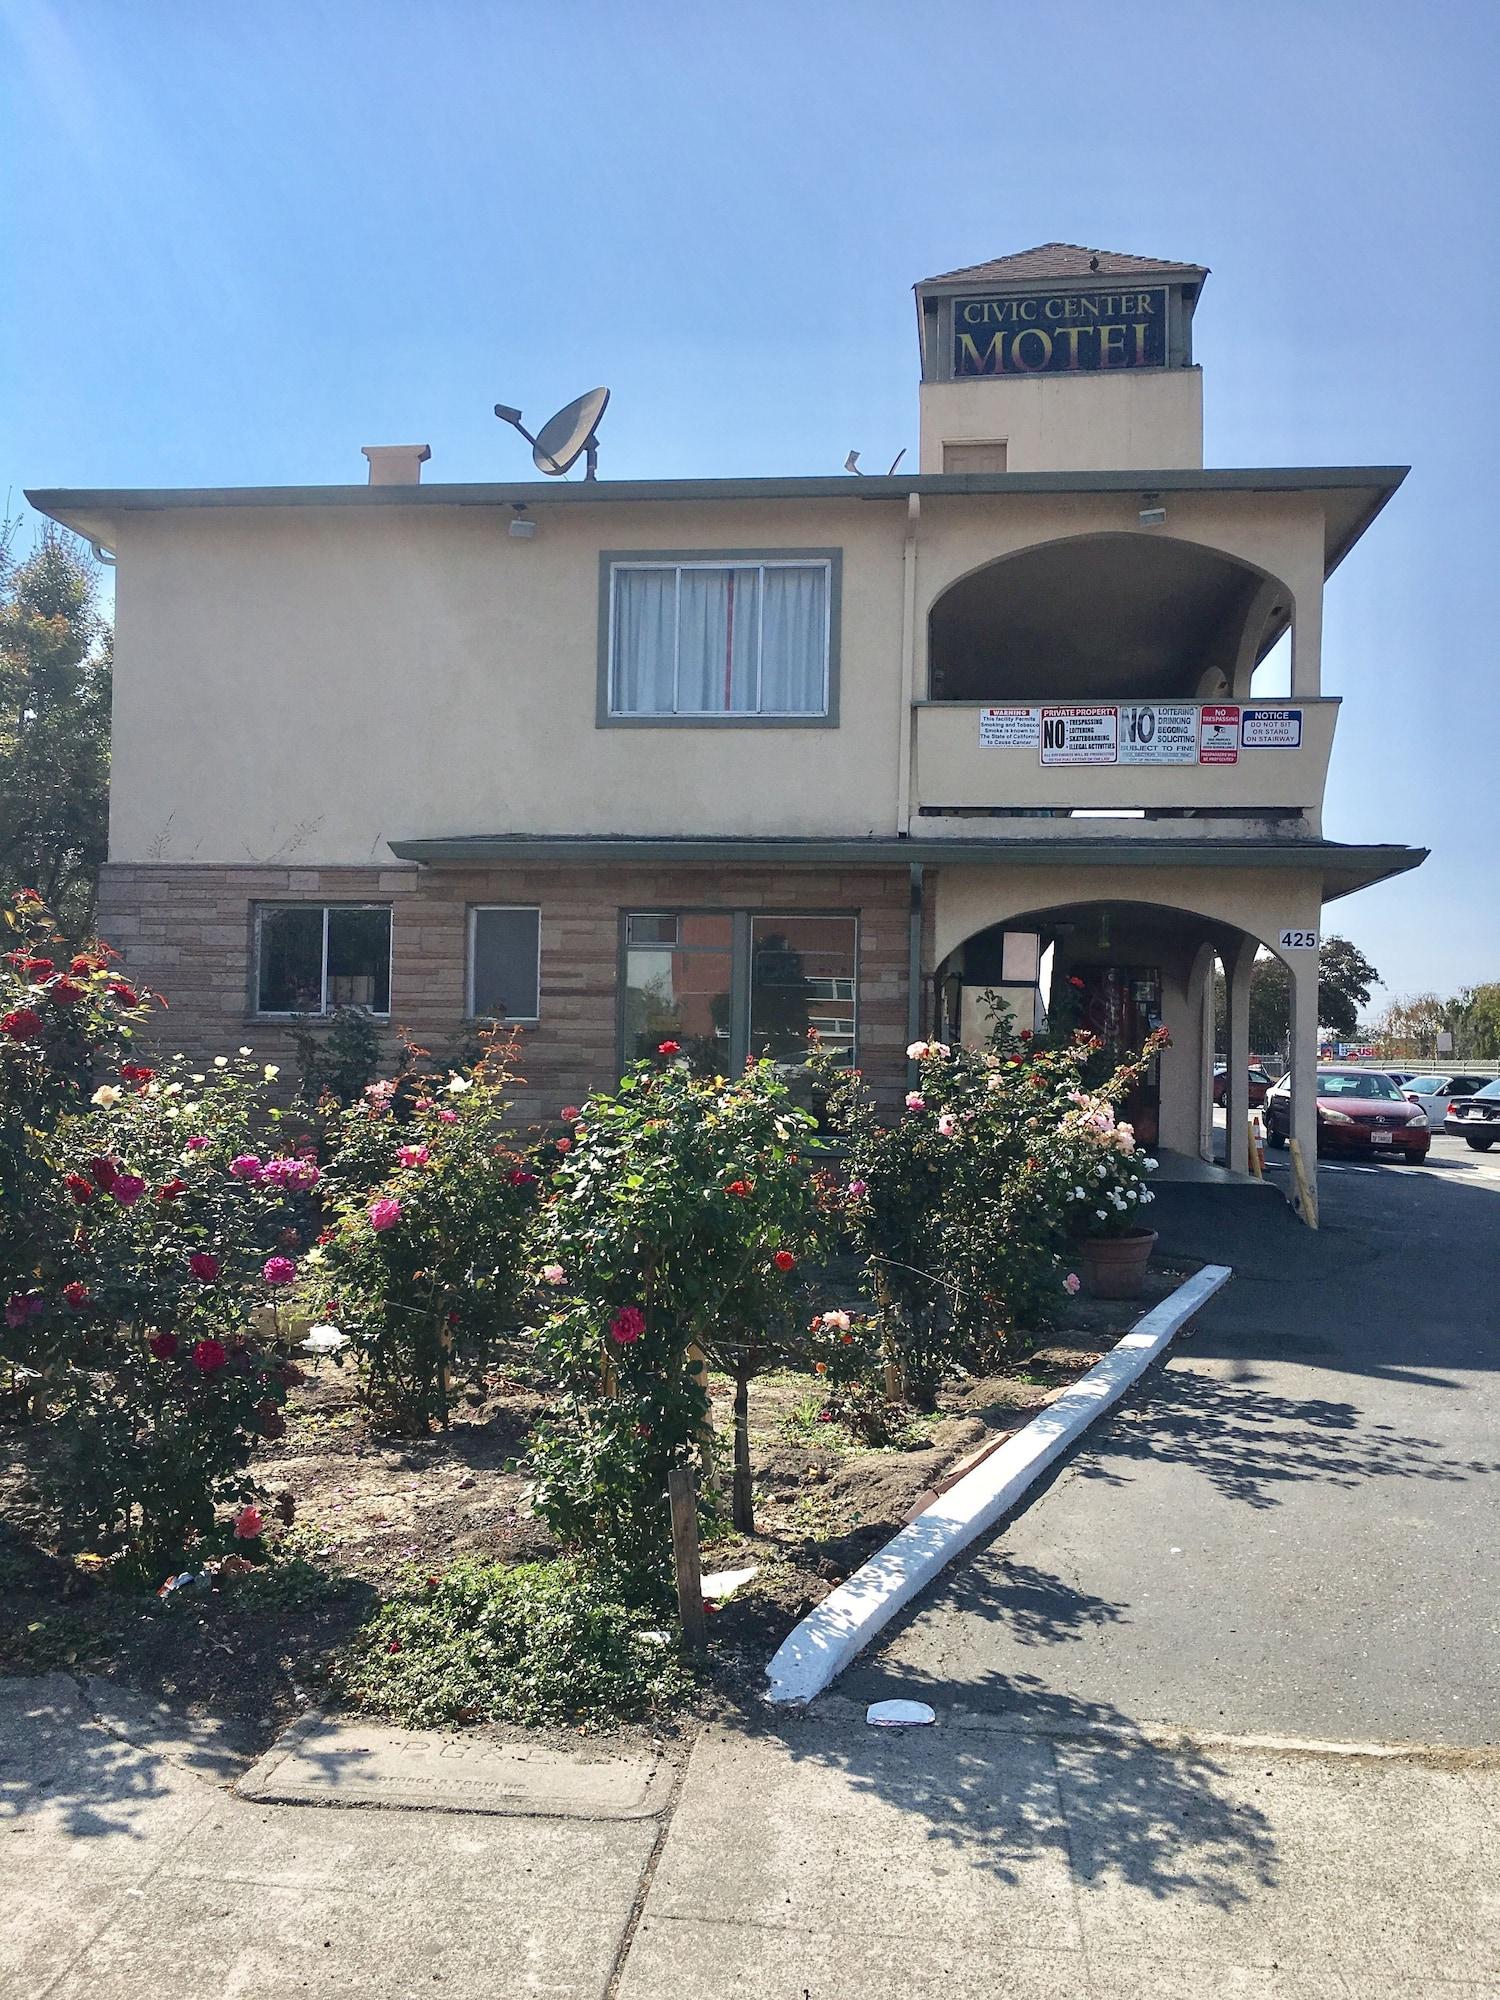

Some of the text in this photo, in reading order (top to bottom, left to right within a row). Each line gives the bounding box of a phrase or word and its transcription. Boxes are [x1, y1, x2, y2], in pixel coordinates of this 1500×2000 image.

[963, 294, 1154, 324] CIVIC CENTER
[956, 322, 1152, 374] MOTEL
[1043, 708, 1116, 717] PRIVATE PROPERTY
[1120, 706, 1155, 743] NO
[1158, 717, 1191, 725] DRINKING
[1043, 719, 1065, 749] NO
[1157, 726, 1188, 734] BEGGING
[1157, 735, 1195, 743] SOLICITING
[1281, 932, 1315, 947] 425
